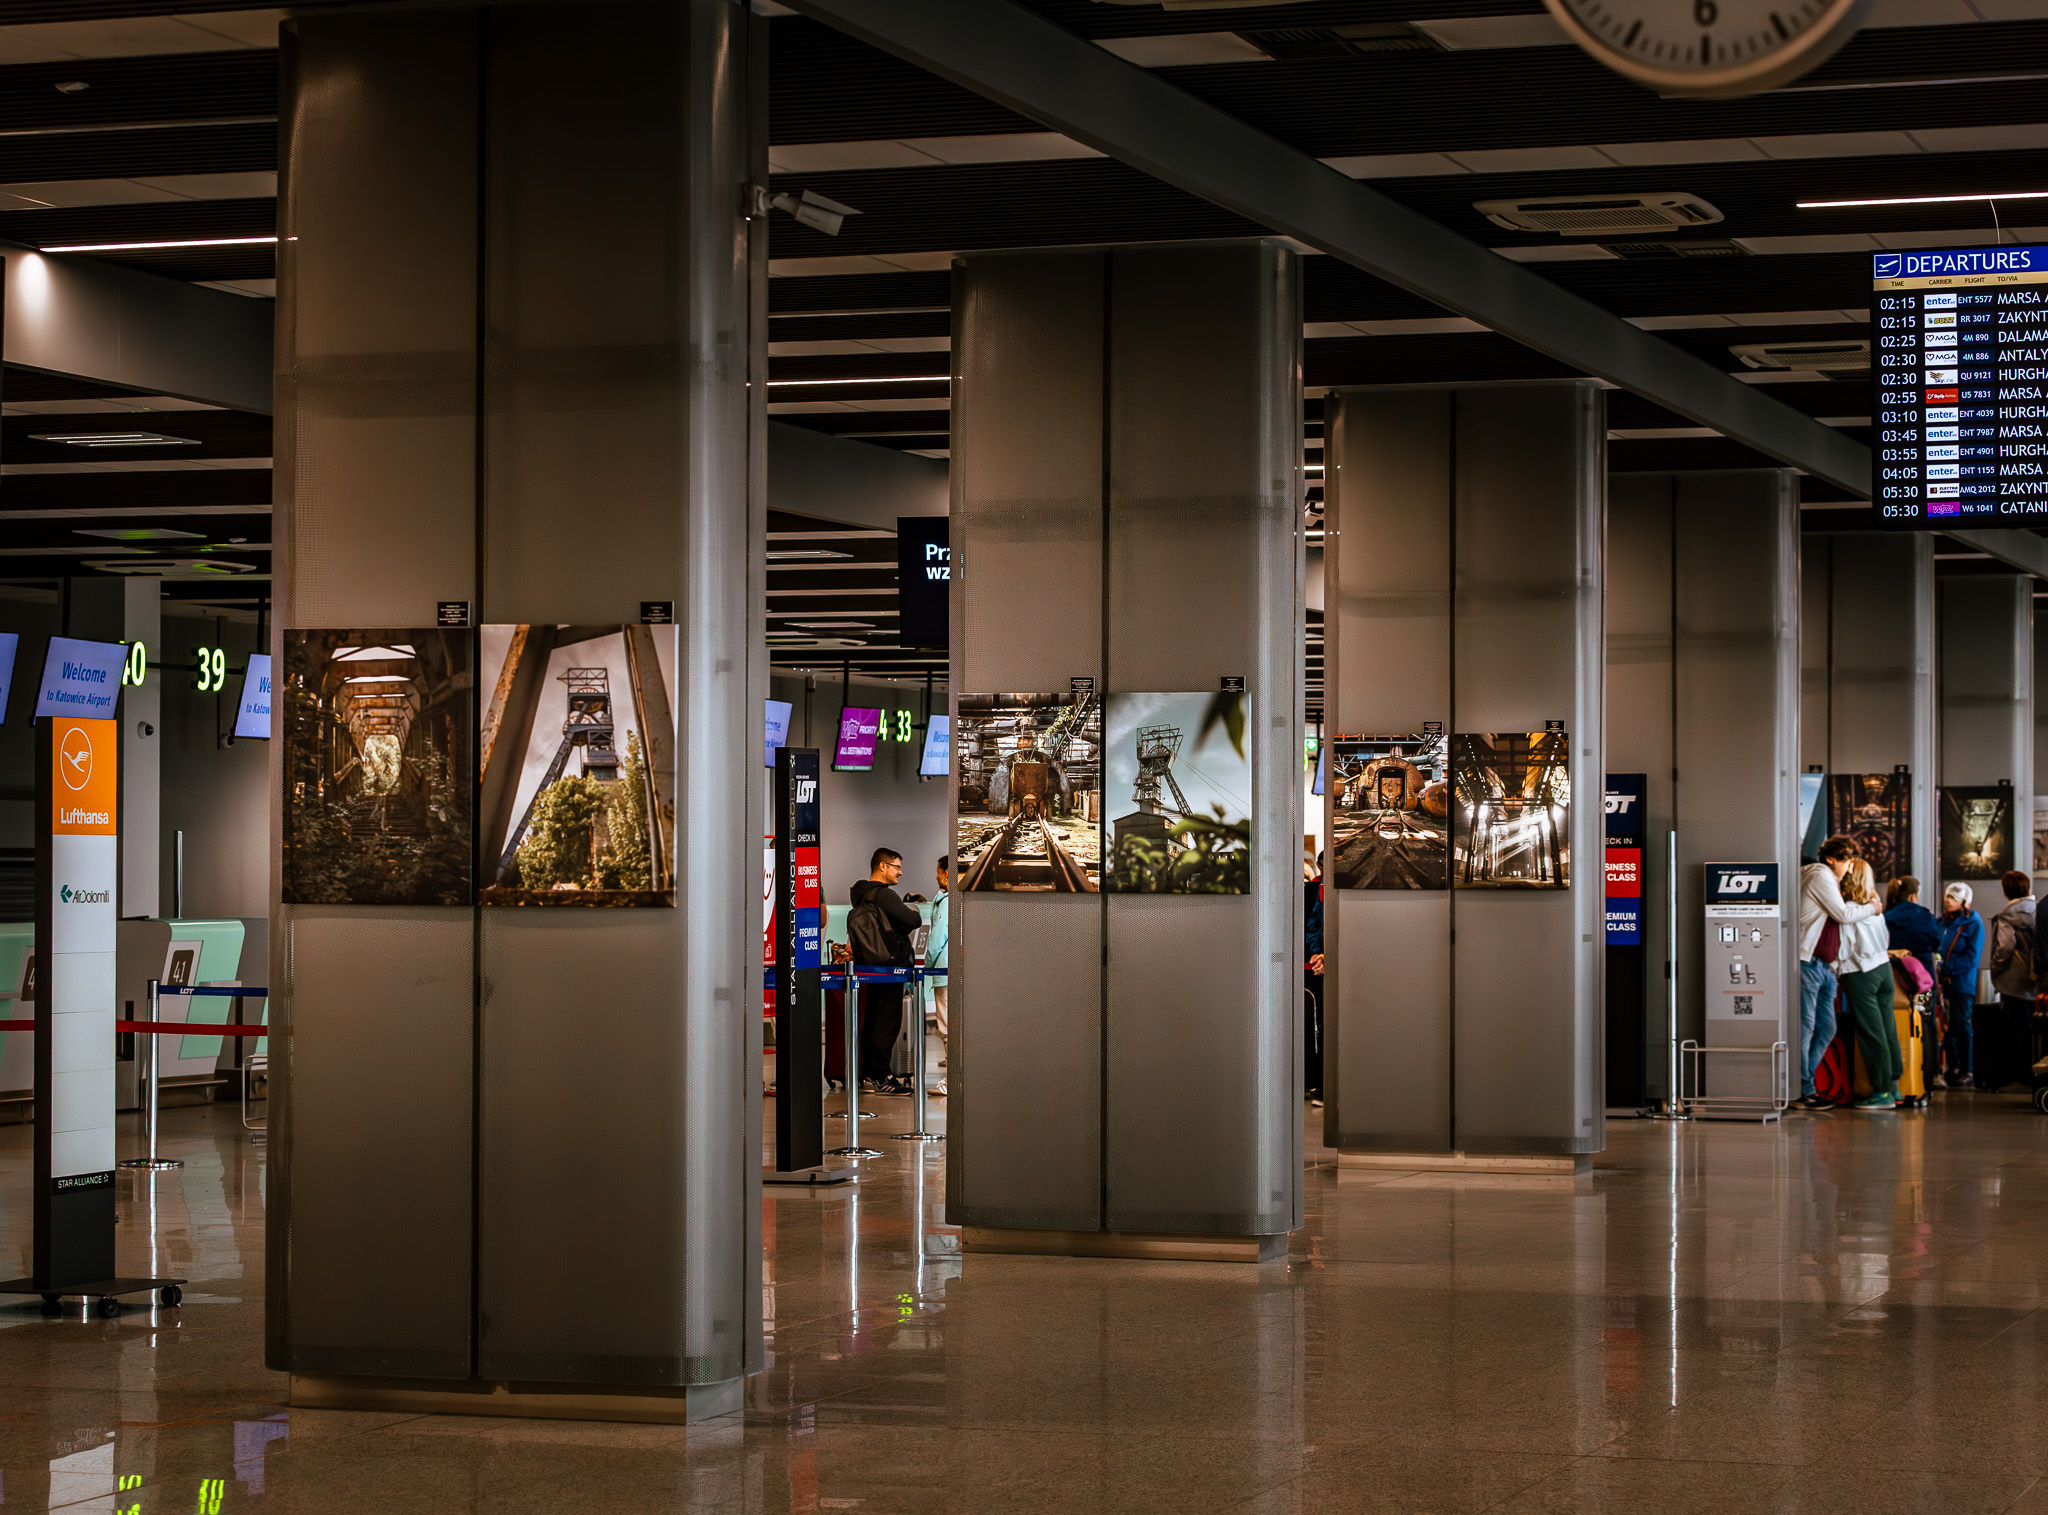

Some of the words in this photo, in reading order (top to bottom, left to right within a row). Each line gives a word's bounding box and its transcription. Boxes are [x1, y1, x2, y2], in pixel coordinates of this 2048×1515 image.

[1907, 251, 2031, 273] DEPARTURES
[1880, 297, 1916, 310] 02:15
[1975, 295, 1992, 303] 5577
[1997, 291, 2041, 305] MARSA
[1880, 316, 1916, 329] 02:15
[1960, 315, 1971, 323] RR
[1973, 314, 1991, 322] 3017
[1998, 310, 2048, 324] ZAKYNT
[1881, 335, 1916, 348] 02:25
[1962, 334, 1973, 342] 4M
[1975, 333, 1989, 341] 890
[1998, 329, 2048, 342] DALAMA
[1881, 354, 1917, 366] 02:30
[1962, 353, 1974, 361] 4M
[1998, 348, 2048, 361] ANTALY
[1881, 373, 1917, 385] 02:30
[1960, 372, 1972, 380] QU
[1881, 391, 1917, 404] 02:55
[1961, 391, 1972, 399] U5
[1998, 387, 2042, 400] MARSA
[1882, 411, 1917, 423] 03:10
[1960, 410, 1974, 418] ENT
[1976, 409, 1994, 417] 4039
[1882, 430, 1917, 441] 03:45
[1977, 428, 1994, 436] 7987
[1999, 425, 2043, 438] MARSA
[1882, 448, 1918, 460] 03:55
[1960, 448, 1975, 456] ENT
[2000, 443, 2048, 457] HURGH
[1882, 467, 1918, 479] 04:05
[1977, 466, 1995, 474] 1155
[2000, 462, 2043, 476] MARSA
[1883, 486, 1919, 498] 05:30
[1960, 486, 1977, 494] AMQ
[1978, 485, 1996, 493] 2012
[2000, 481, 2048, 495] ZAKYNT
[1883, 505, 1919, 517] 05:30
[2000, 501, 2048, 514] CATANI
[926, 567, 950, 579] wz
[62, 661, 106, 683] Welcome
[197, 647, 225, 692] 39
[259, 676, 271, 693] We
[46, 689, 54, 701] to
[55, 690, 85, 704] Katowice
[86, 693, 111, 708] Airport
[246, 703, 251, 713] to
[877, 709, 888, 742] 4
[896, 710, 911, 742] 33
[796, 781, 816, 803] LOT
[61, 808, 108, 824] Lufthansa
[798, 834, 811, 842] CHECK
[798, 865, 818, 876] BUSINESS
[1607, 873, 1636, 881] CLASS
[804, 878, 818, 888] CLASS
[1717, 875, 1766, 893] LOT
[799, 927, 818, 938] PREMIUM
[1607, 923, 1636, 931] CLASS
[804, 941, 818, 951] CLASS
[173, 961, 187, 983] 41
[58, 1179, 73, 1188] STAR
[74, 1175, 102, 1187] ALLIANCE
